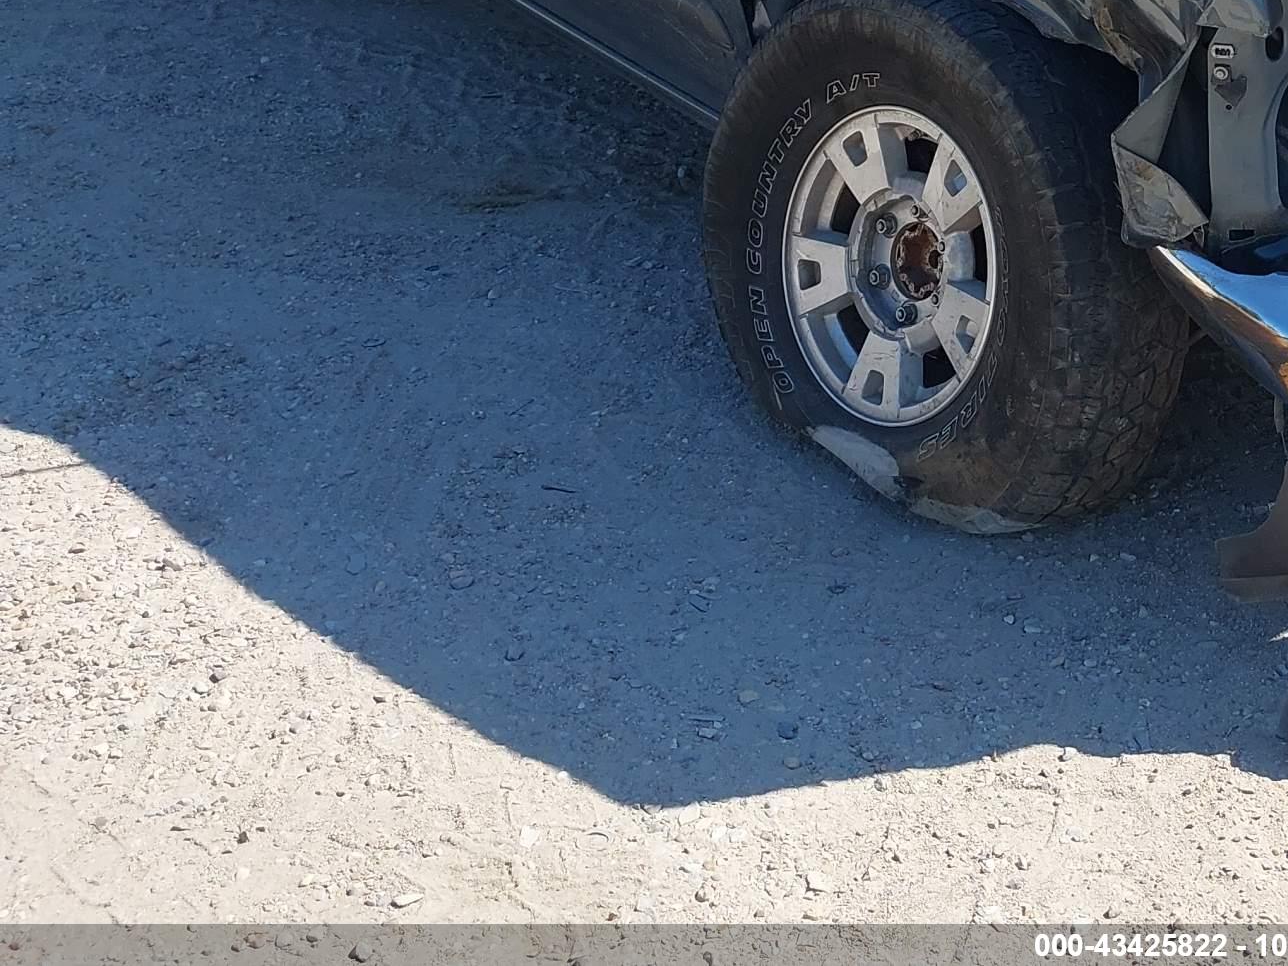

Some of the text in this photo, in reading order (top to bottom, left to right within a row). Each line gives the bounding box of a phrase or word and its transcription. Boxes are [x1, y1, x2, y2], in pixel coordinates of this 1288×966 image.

[746, 71, 881, 395] OPEN COUNTRY A/T
[916, 352, 998, 463] TIRES
